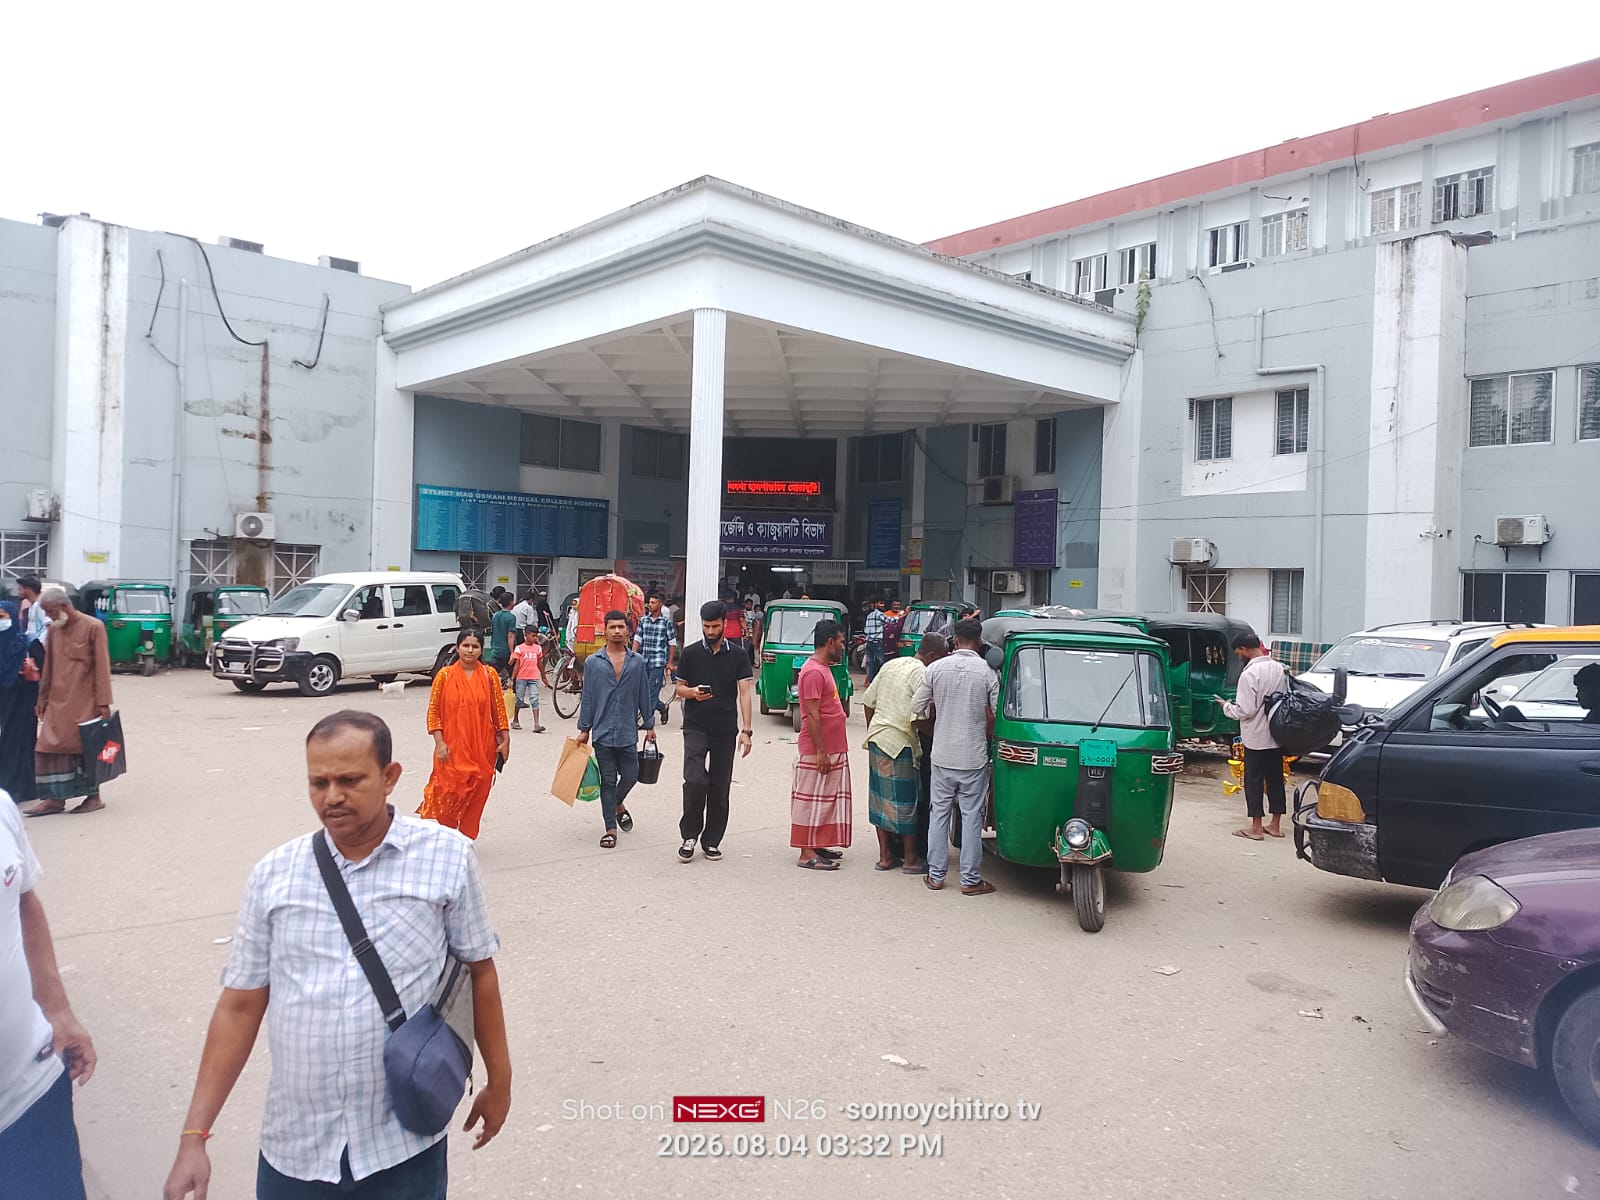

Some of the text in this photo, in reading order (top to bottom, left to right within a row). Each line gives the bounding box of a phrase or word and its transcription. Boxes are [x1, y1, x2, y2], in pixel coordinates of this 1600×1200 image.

[507, 495, 539, 503] MEDICAL
[541, 497, 573, 506] COLLEGE
[574, 500, 607, 509] HOSPITAL
[747, 522, 755, 537] ও
[801, 518, 826, 540] বিভাগ
